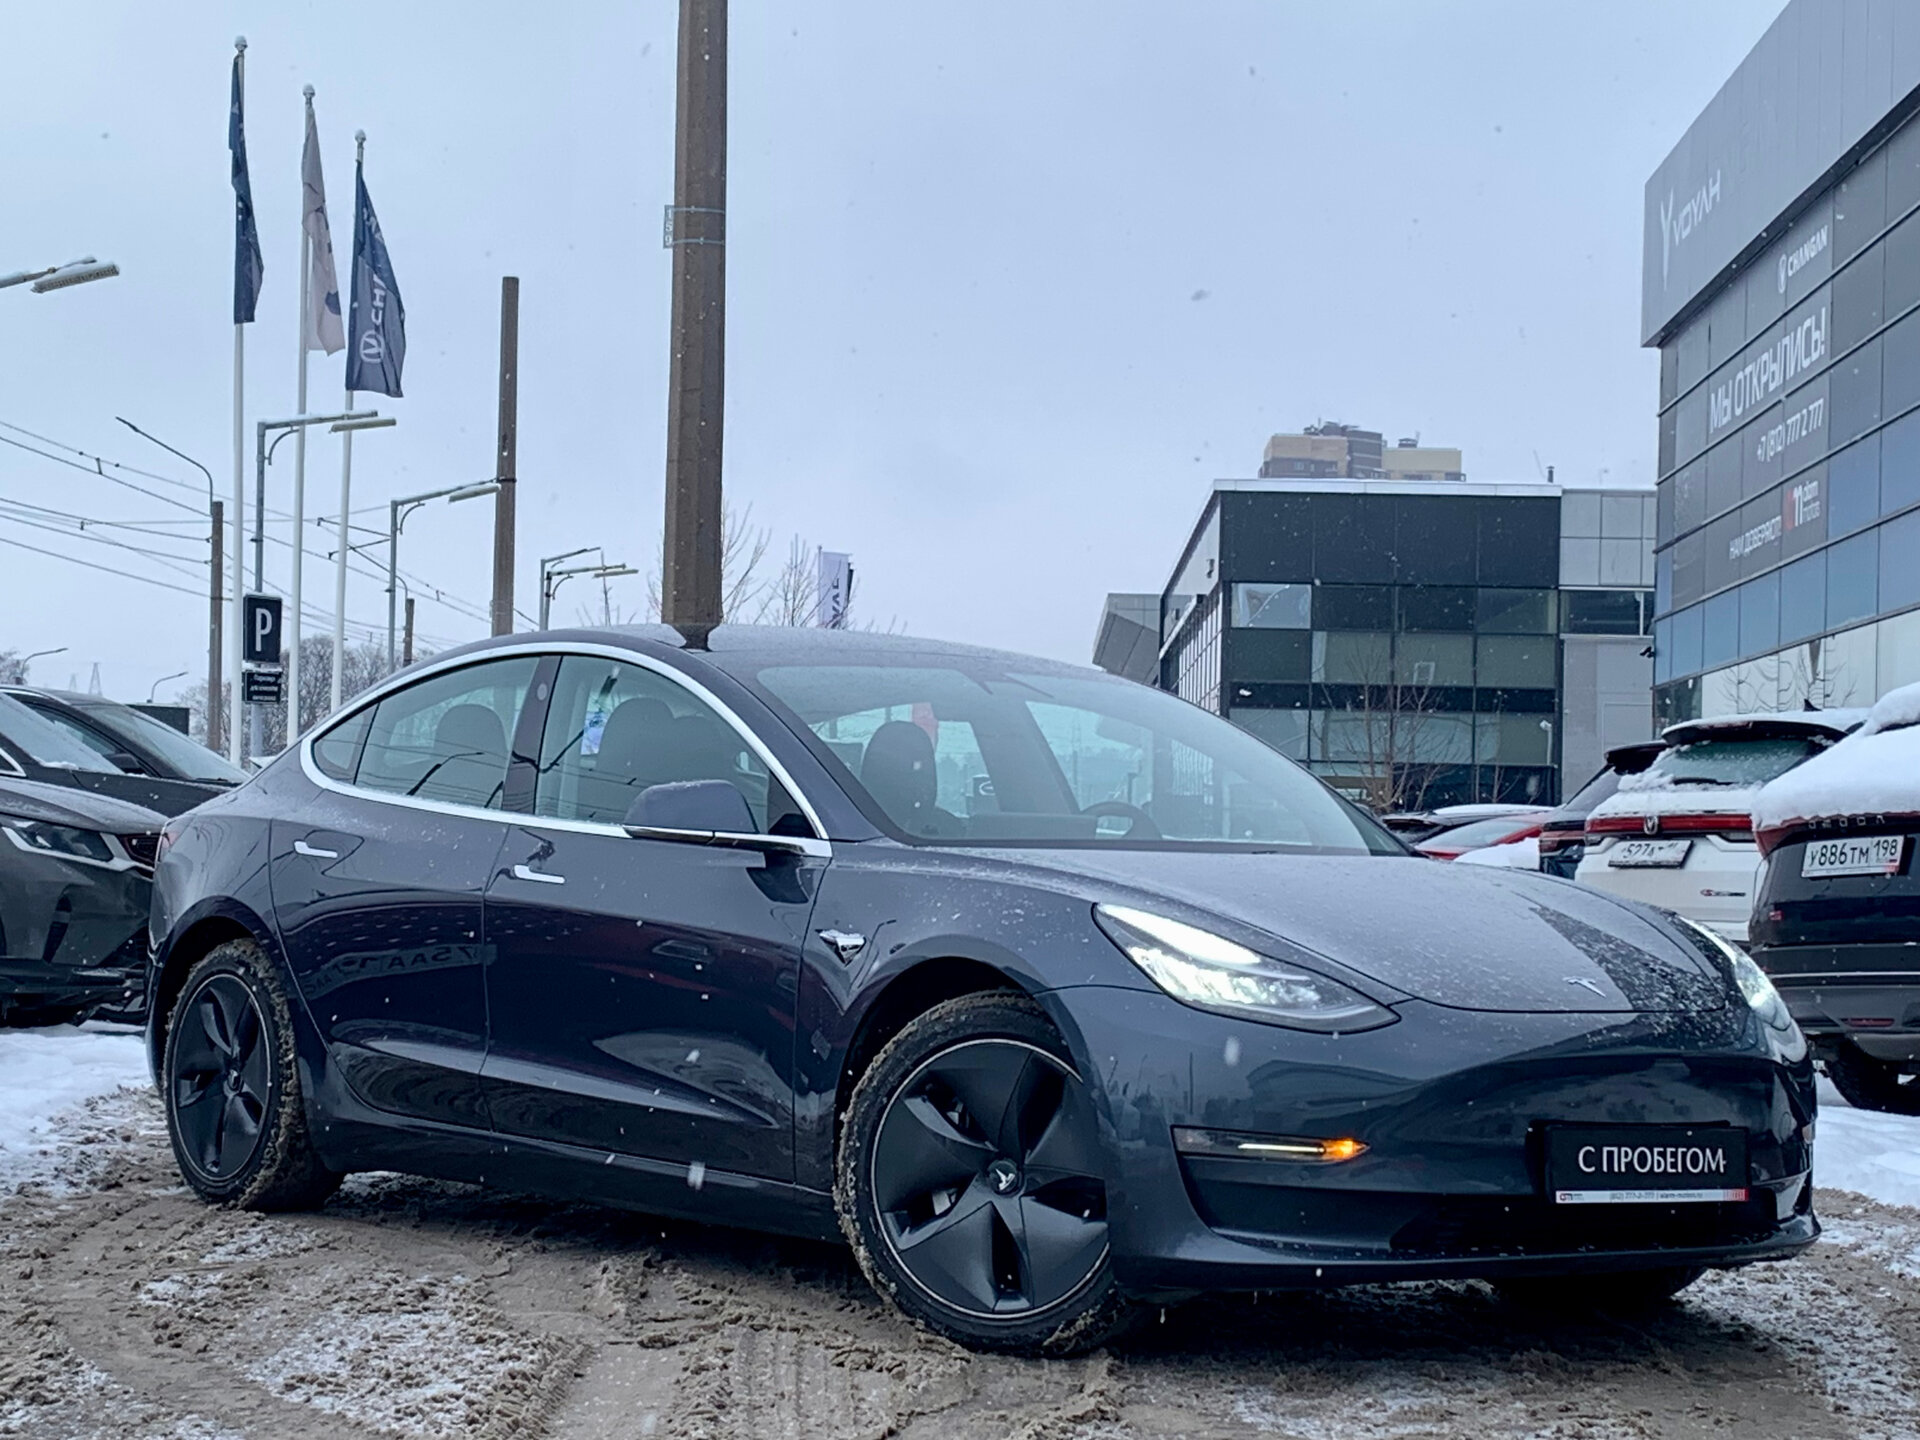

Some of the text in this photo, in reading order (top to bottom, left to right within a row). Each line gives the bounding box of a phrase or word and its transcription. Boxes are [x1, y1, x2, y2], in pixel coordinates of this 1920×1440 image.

[1672, 169, 1721, 247] VOYAH
[1787, 224, 1828, 277] CHANGAN
[1709, 307, 1826, 434] МЫ ОТКРЫЛИСЬ!
[1786, 412, 1801, 446] 777
[1801, 408, 1808, 437] 2
[1808, 398, 1824, 433] 777
[255, 607, 272, 652] P
[1873, 839, 1898, 857] 198
[1578, 1146, 1724, 1173] С ПРОБЕГОМ
